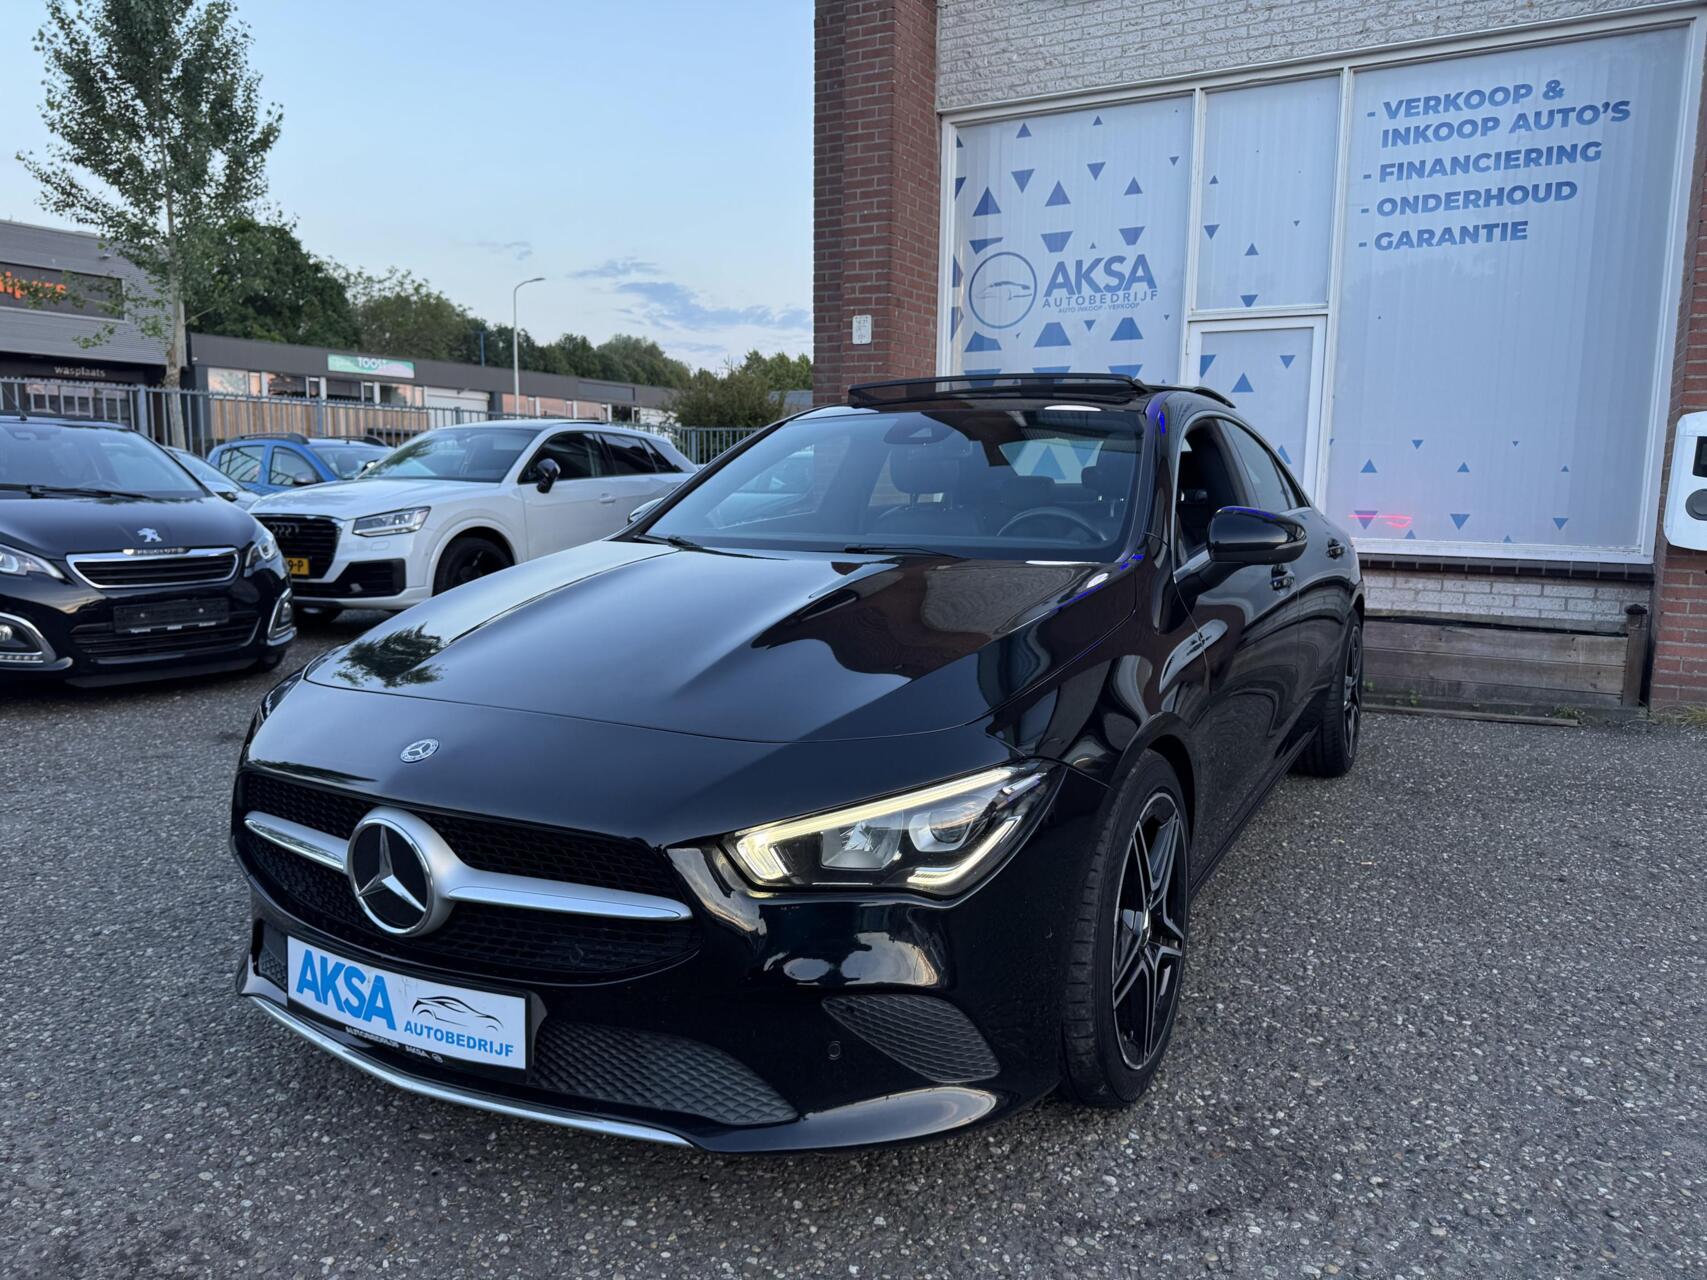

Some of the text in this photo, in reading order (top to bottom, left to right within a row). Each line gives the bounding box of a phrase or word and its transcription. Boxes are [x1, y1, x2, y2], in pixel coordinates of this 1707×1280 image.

[1383, 83, 1533, 120] VERKOOP
[1542, 79, 1566, 101] &
[1381, 100, 1631, 149] INKOOP AUTO'S
[1379, 141, 1602, 183] FINANCIERING
[1376, 180, 1578, 217] ONDERHOUD
[1374, 220, 1529, 251] GARANTIE
[1043, 254, 1157, 297] AKSA
[1042, 290, 1158, 308] AUTOBEDRIJF
[1058, 306, 1076, 314] AUTO
[1077, 305, 1103, 313] INKOOP
[1108, 302, 1140, 311] VERKOOP
[54, 366, 106, 378] wasplaats
[296, 949, 397, 1031] AKSA
[403, 1020, 514, 1057] AUTOBEDRIJF
